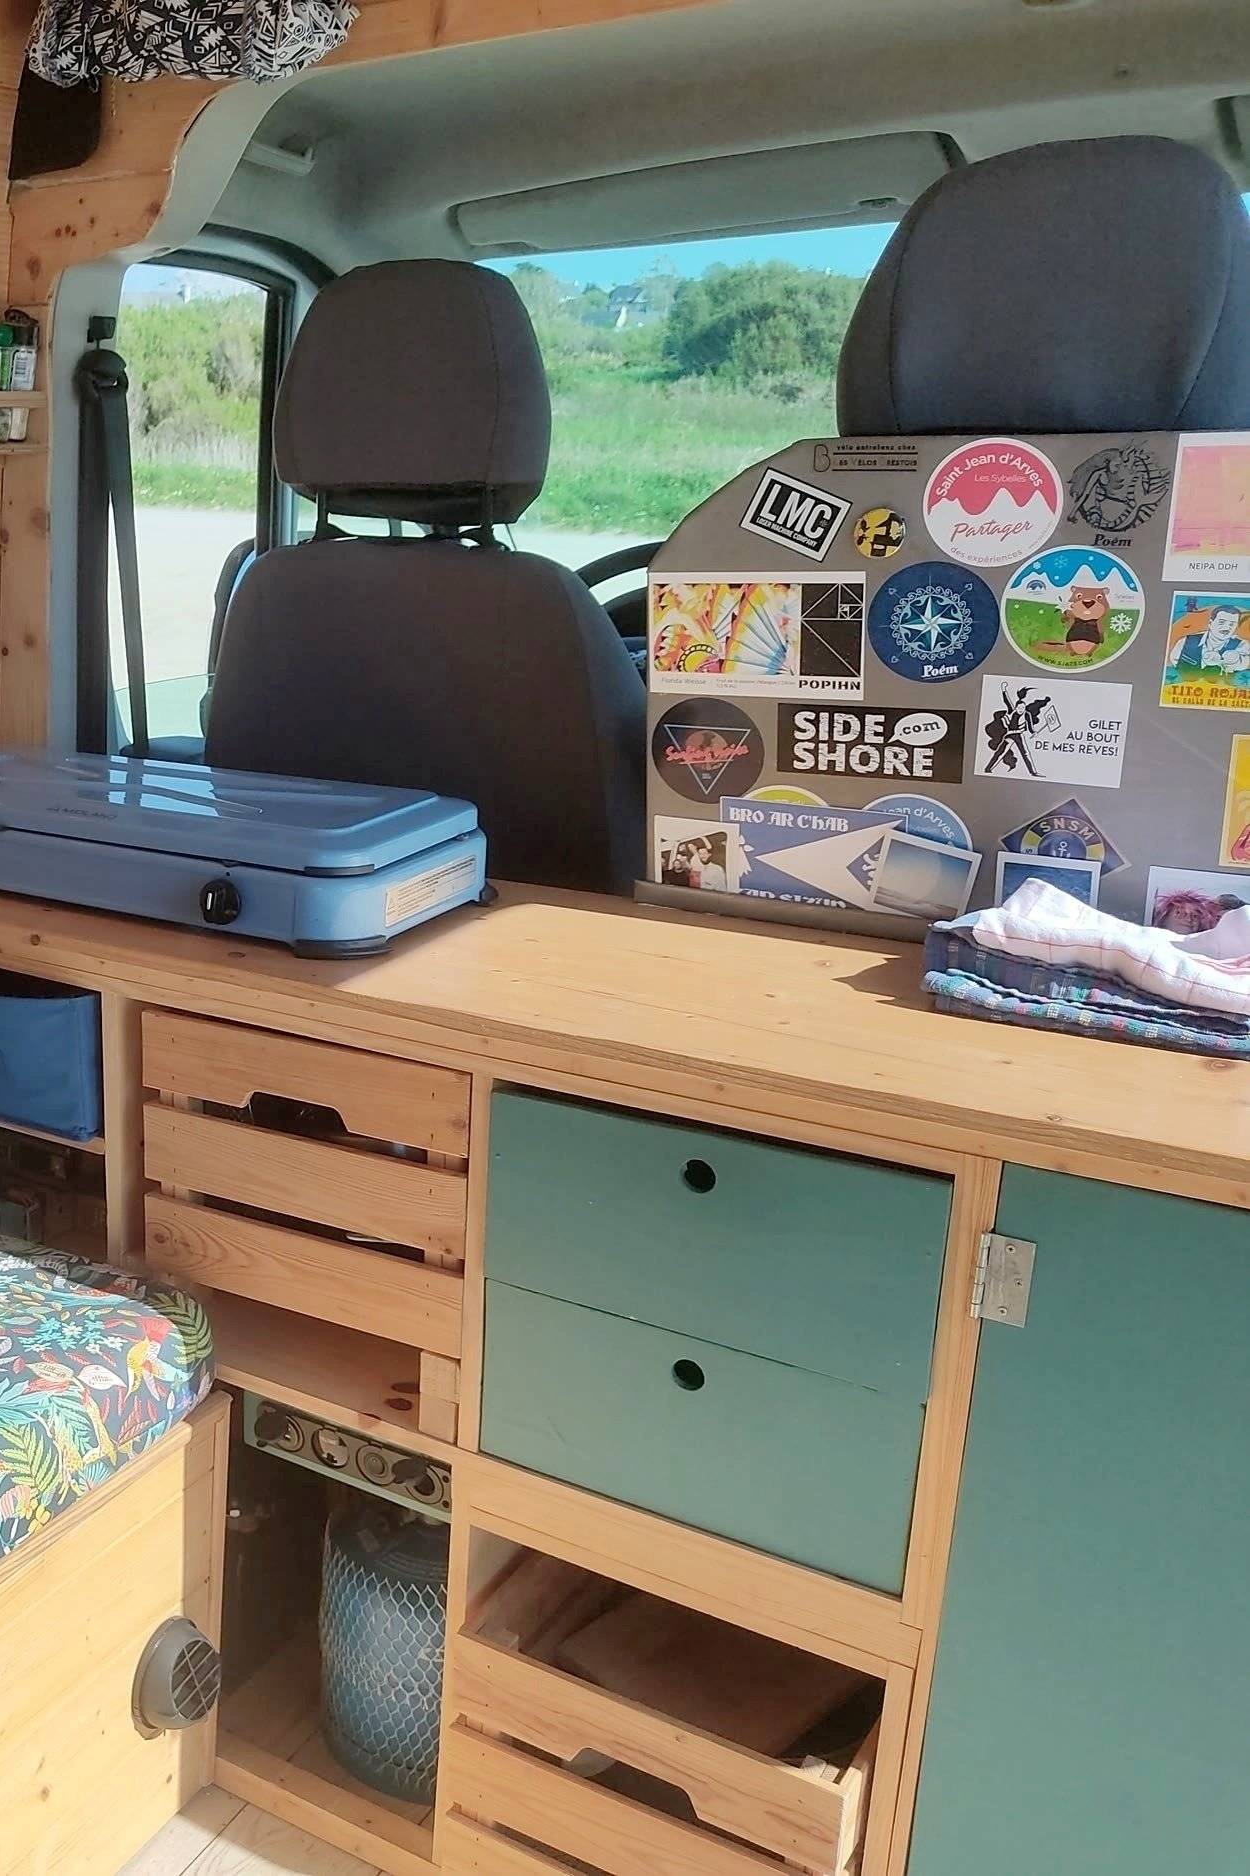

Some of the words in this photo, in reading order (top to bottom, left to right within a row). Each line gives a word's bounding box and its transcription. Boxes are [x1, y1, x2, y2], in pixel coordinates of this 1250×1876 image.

[936, 466, 963, 497] Saint
[964, 453, 996, 471] Jean
[999, 453, 1043, 487] d'Arves
[991, 475, 1027, 484] Sybelles
[760, 484, 832, 539] LMC
[950, 520, 1032, 542] Partager
[950, 545, 965, 558] des
[966, 548, 1023, 563] expériences
[1188, 562, 1216, 570] NEIPA
[1217, 562, 1239, 571] DDH
[798, 679, 860, 690] POPIHN
[1171, 685, 1204, 697] TITO
[793, 711, 886, 744] SIDE
[899, 721, 941, 736] .com
[1088, 719, 1122, 731] GILET
[1066, 731, 1083, 741] AU
[1086, 734, 1120, 744] BOUT
[1034, 740, 1049, 750] DE
[1052, 743, 1075, 753] MES
[1078, 743, 1118, 756] RÊVES!
[793, 741, 934, 777] SHORE
[729, 806, 765, 823] BRO
[767, 811, 794, 828] AR
[913, 807, 955, 840] d'Arves
[1039, 817, 1095, 841] SNSM
